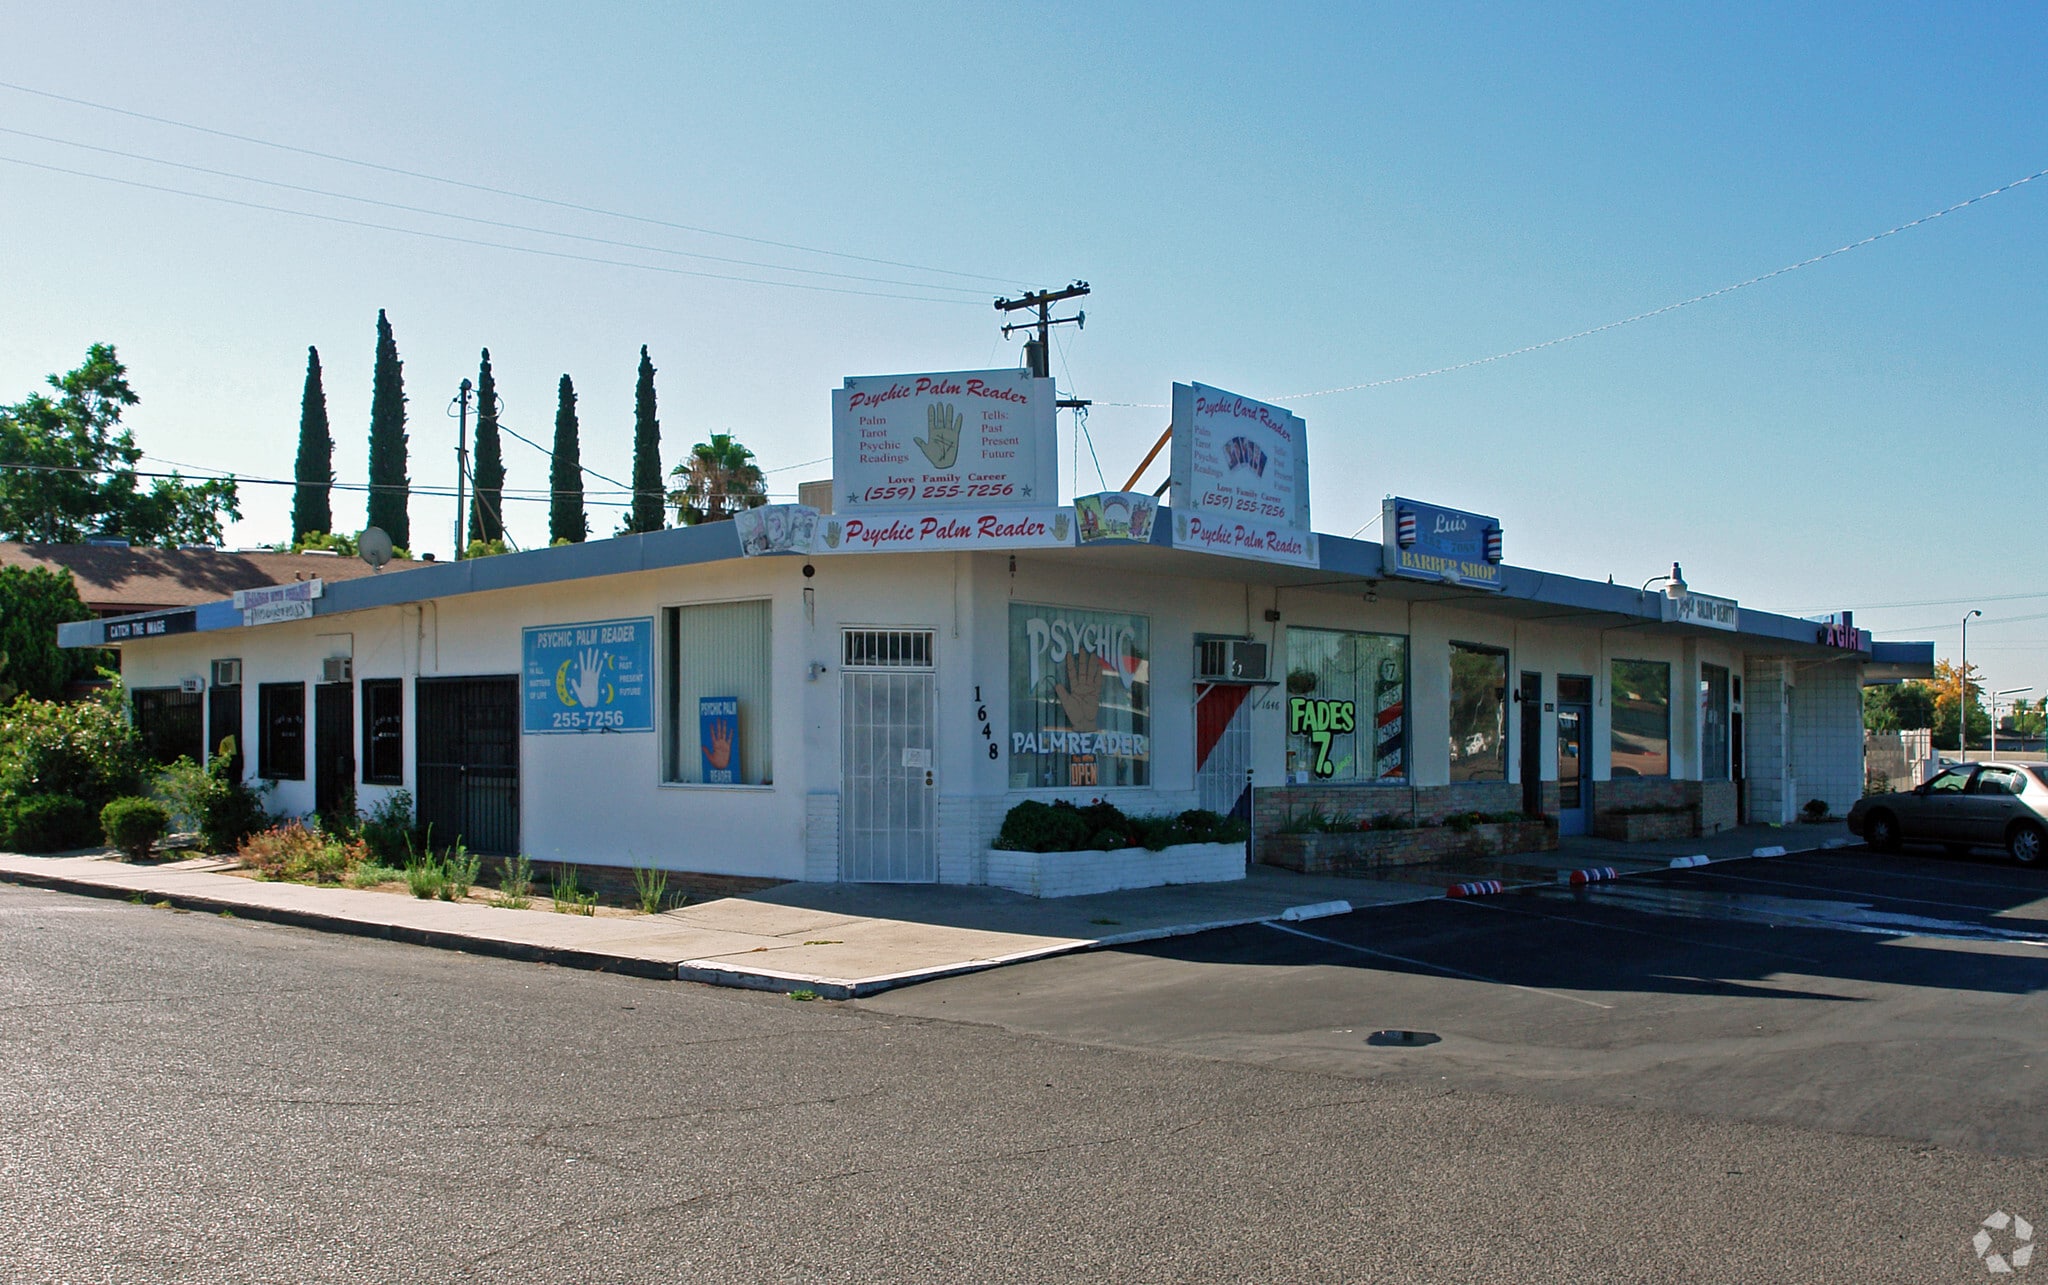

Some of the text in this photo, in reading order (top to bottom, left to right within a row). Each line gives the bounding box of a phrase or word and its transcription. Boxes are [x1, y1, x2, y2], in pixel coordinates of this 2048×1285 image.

[849, 378, 1029, 411] Psychic Palm Reader
[859, 416, 886, 425] Palm
[981, 411, 1009, 420] Tells:
[1196, 397, 1292, 443] Psychic Card Reader
[860, 429, 887, 438] Tarot
[981, 424, 1002, 433] Past
[860, 441, 900, 451] Psychic
[981, 437, 1019, 446] Present
[860, 453, 909, 464] Readings
[981, 449, 1015, 459] Future
[888, 473, 1006, 484] Love Family Career
[864, 484, 1013, 502] (559) 255-7256
[1217, 483, 1281, 503] Love Family Career
[1202, 491, 1285, 518] (559) 255-7256
[845, 515, 1045, 547] Psychic Palm Reader
[1433, 514, 1467, 534] Luis
[1190, 518, 1302, 554] Psychic Palm Reader
[1461, 562, 1496, 579] SHOP
[110, 624, 130, 638] CATCH
[132, 622, 144, 635] THE
[537, 625, 634, 649] PSYCHIC PALM READER
[1837, 625, 1864, 650] GIRL
[1026, 618, 1135, 694] PSYCHIC
[619, 674, 643, 682] PRESENT
[701, 701, 736, 716] PSYCHIC PALM
[1290, 697, 1355, 734] FADES
[553, 711, 624, 728] 255-7256
[710, 770, 732, 783] READER
[1071, 763, 1098, 786] OPEN
